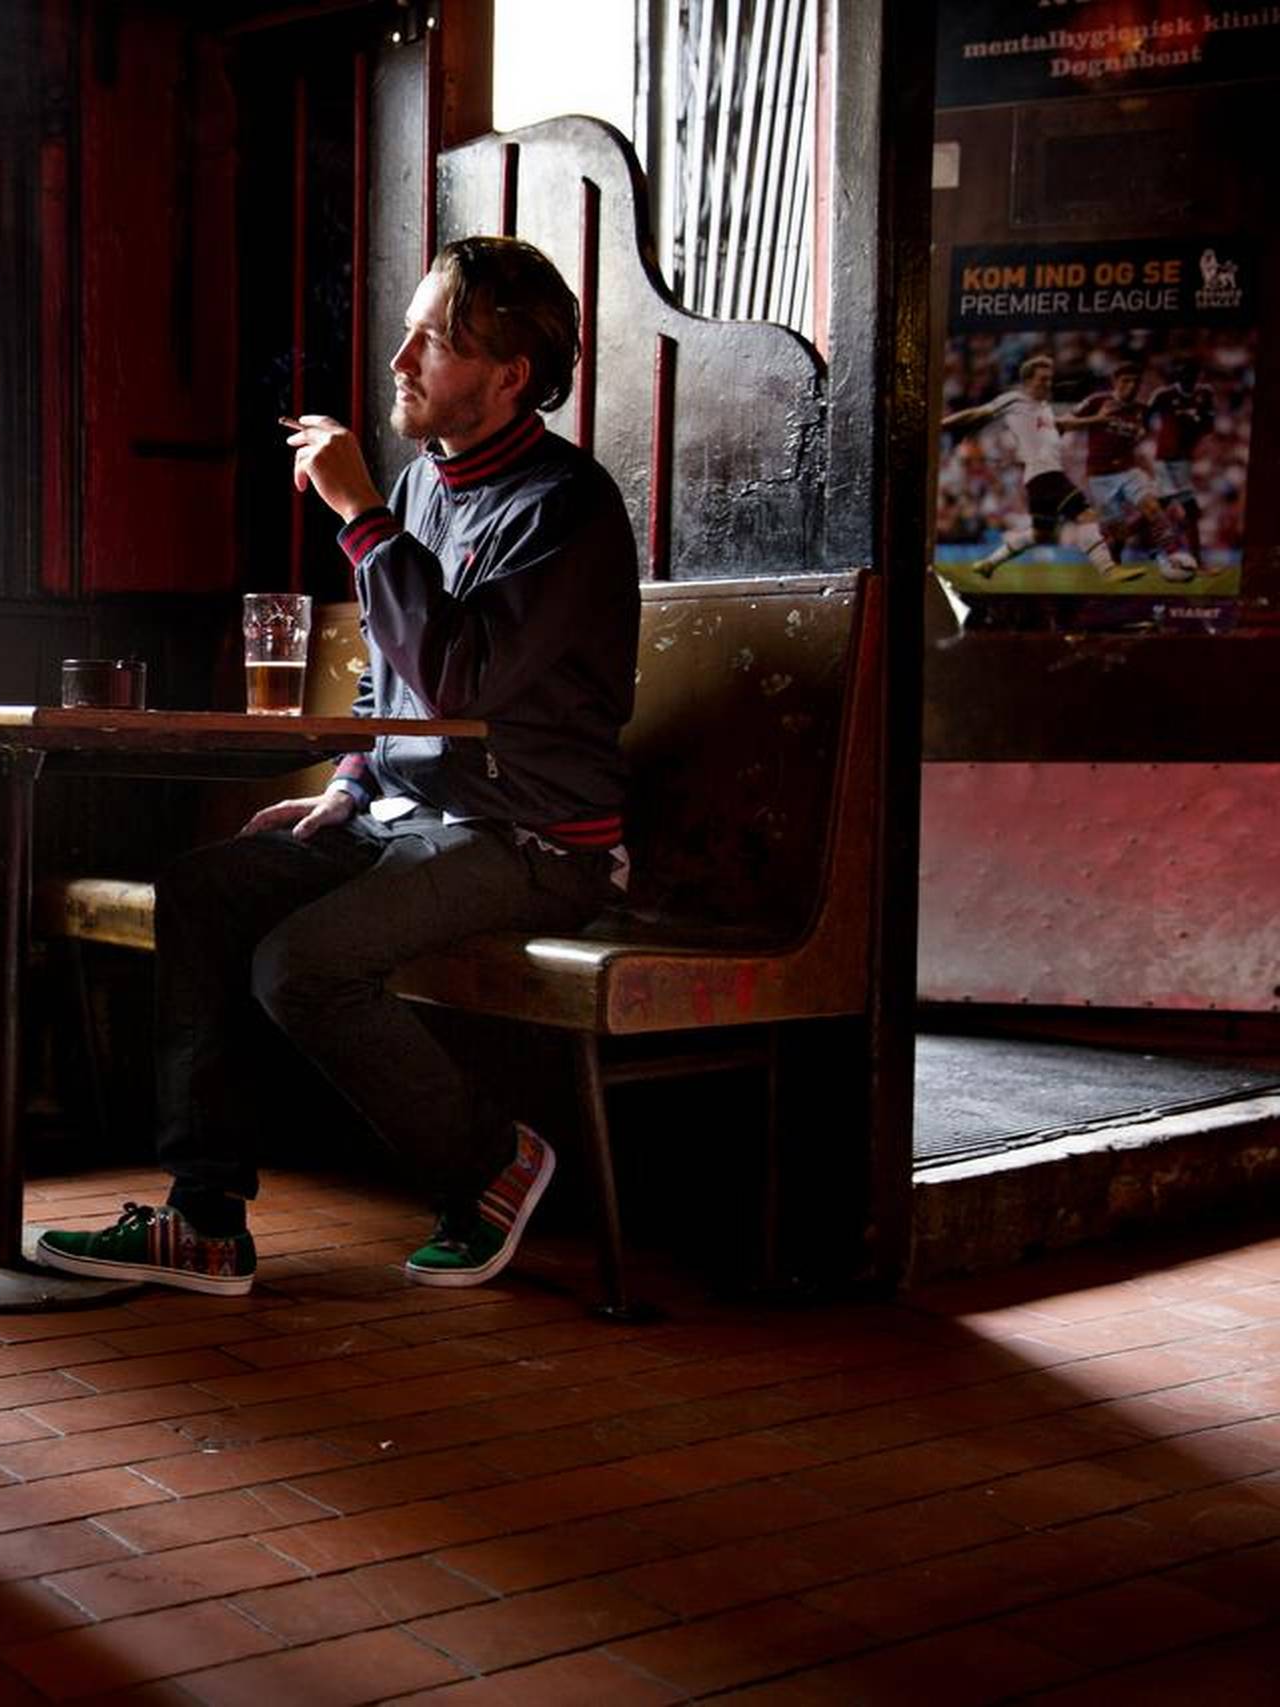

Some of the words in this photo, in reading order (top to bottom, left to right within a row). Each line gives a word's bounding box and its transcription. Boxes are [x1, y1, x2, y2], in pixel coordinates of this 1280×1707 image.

[962, 265, 1027, 291] KOM
[1035, 262, 1087, 289] IND
[1093, 260, 1136, 286] OG
[1142, 259, 1184, 285] SE
[961, 292, 1071, 316] PREMIER
[1078, 289, 1181, 313] LEAGUE
